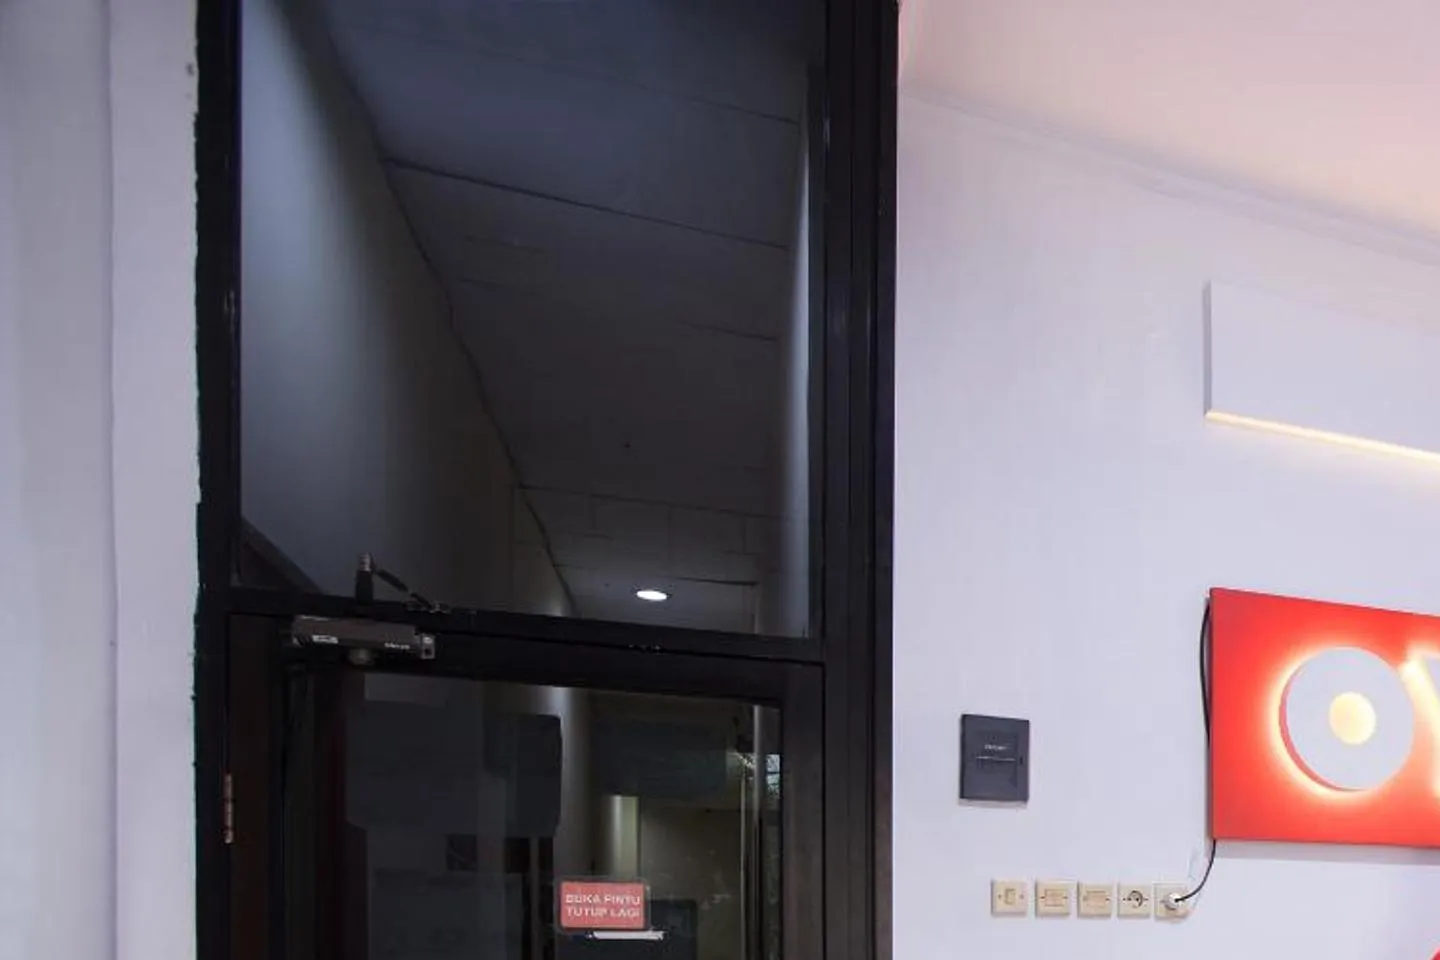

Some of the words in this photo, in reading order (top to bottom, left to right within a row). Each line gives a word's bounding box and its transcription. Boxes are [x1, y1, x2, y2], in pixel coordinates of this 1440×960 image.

[565, 894, 600, 904] BUKA
[604, 895, 641, 905] PINTU
[566, 907, 607, 917] TUTUP
[610, 908, 640, 918] LAGI
